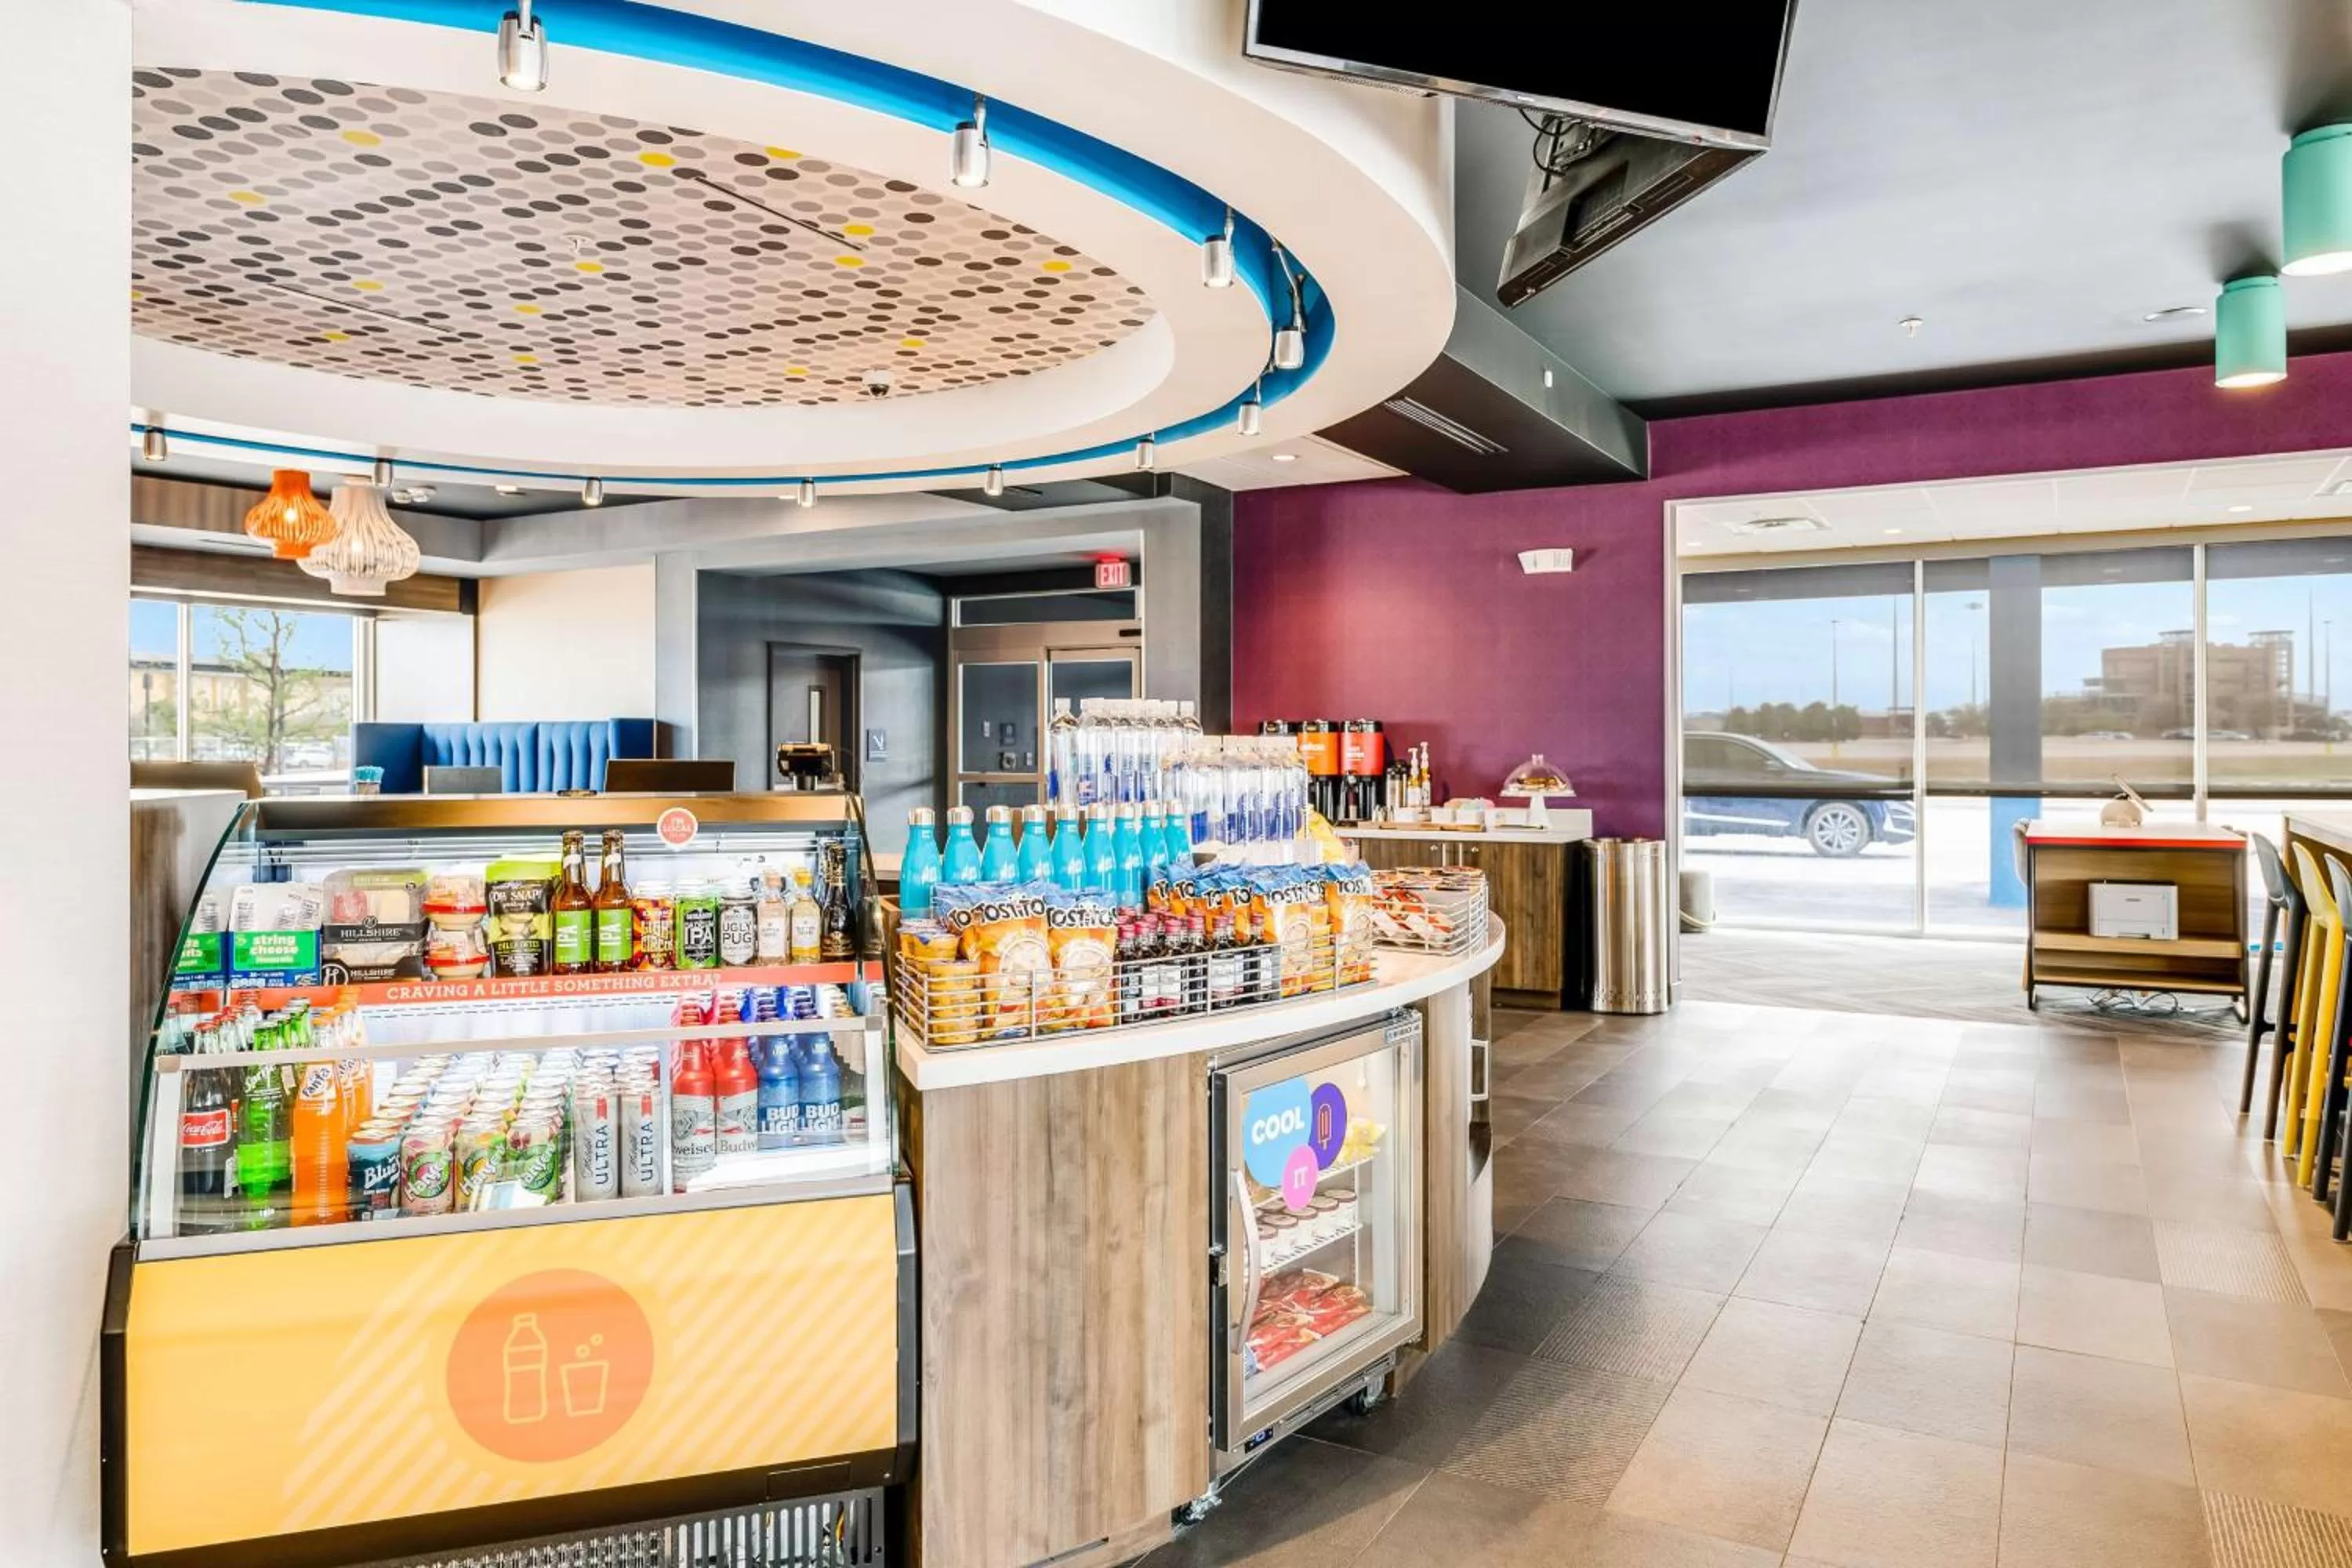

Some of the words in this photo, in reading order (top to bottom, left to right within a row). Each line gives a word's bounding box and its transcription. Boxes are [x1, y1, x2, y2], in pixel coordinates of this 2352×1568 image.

[1100, 564, 1127, 586] EXIT
[971, 895, 1046, 923] TOSTITO
[340, 928, 401, 938] HILLSHIRE
[557, 925, 578, 947] IPA
[601, 924, 622, 946] IPA
[684, 927, 713, 946] IPA
[723, 921, 752, 932] UGLY
[249, 945, 299, 954] cheese
[252, 935, 296, 946] string
[722, 932, 753, 945] PUG
[387, 985, 468, 1000] CRAVING
[474, 984, 485, 996] A
[491, 981, 549, 996] LITTLE
[554, 977, 655, 993] SOMETHING
[660, 973, 722, 988] EXTRA?
[303, 1066, 330, 1097] Fanta
[767, 1104, 800, 1120] BUD
[805, 1102, 839, 1119] BUD
[761, 1119, 800, 1134] LIGH
[1251, 1106, 1305, 1145] COOL
[595, 1124, 609, 1185] ULTRA
[641, 1120, 653, 1181] ULTRA
[1293, 1166, 1308, 1189] IT
